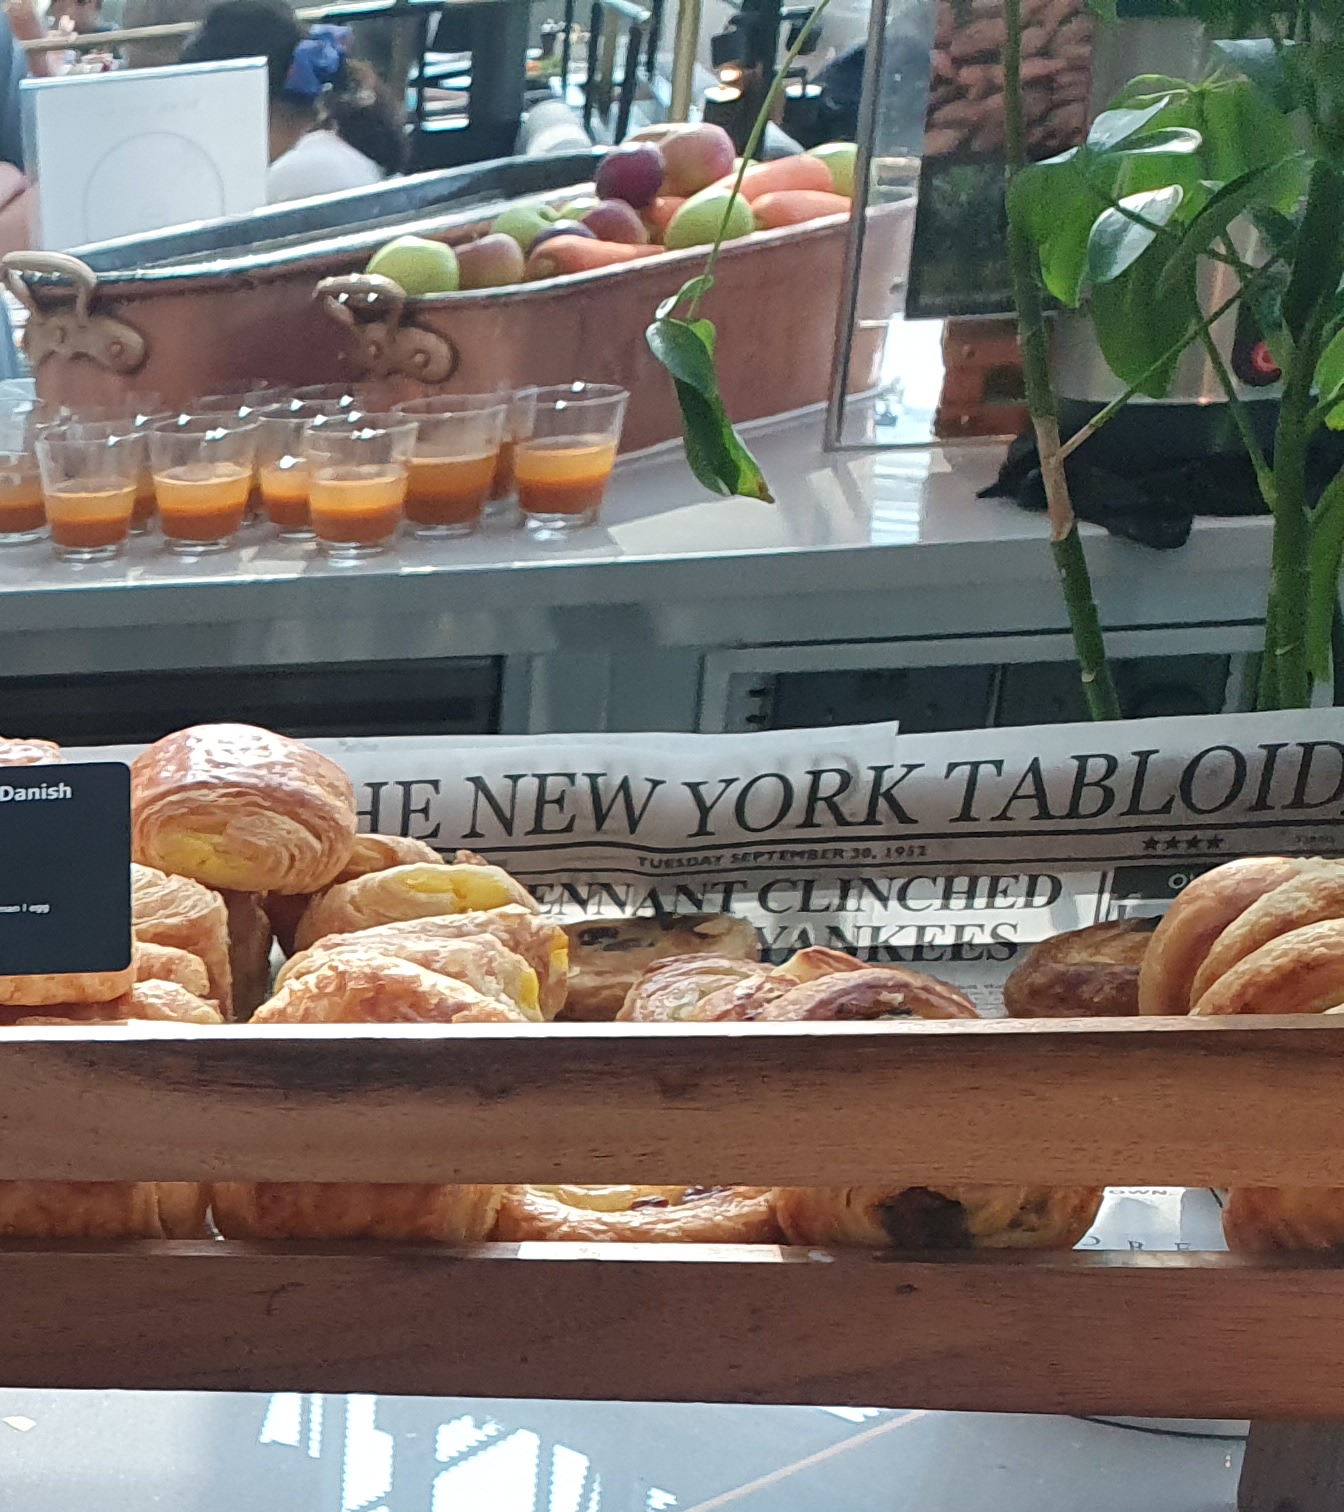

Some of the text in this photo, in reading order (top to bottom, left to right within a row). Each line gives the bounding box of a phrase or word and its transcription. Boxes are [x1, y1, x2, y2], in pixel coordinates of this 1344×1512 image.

[355, 739, 1344, 839] HE NEW YORK TABLOID
[637, 854, 724, 870] TUESDAY
[730, 848, 845, 866] SEPTEMBER
[528, 872, 1064, 917] ENNANT CLINCHED
